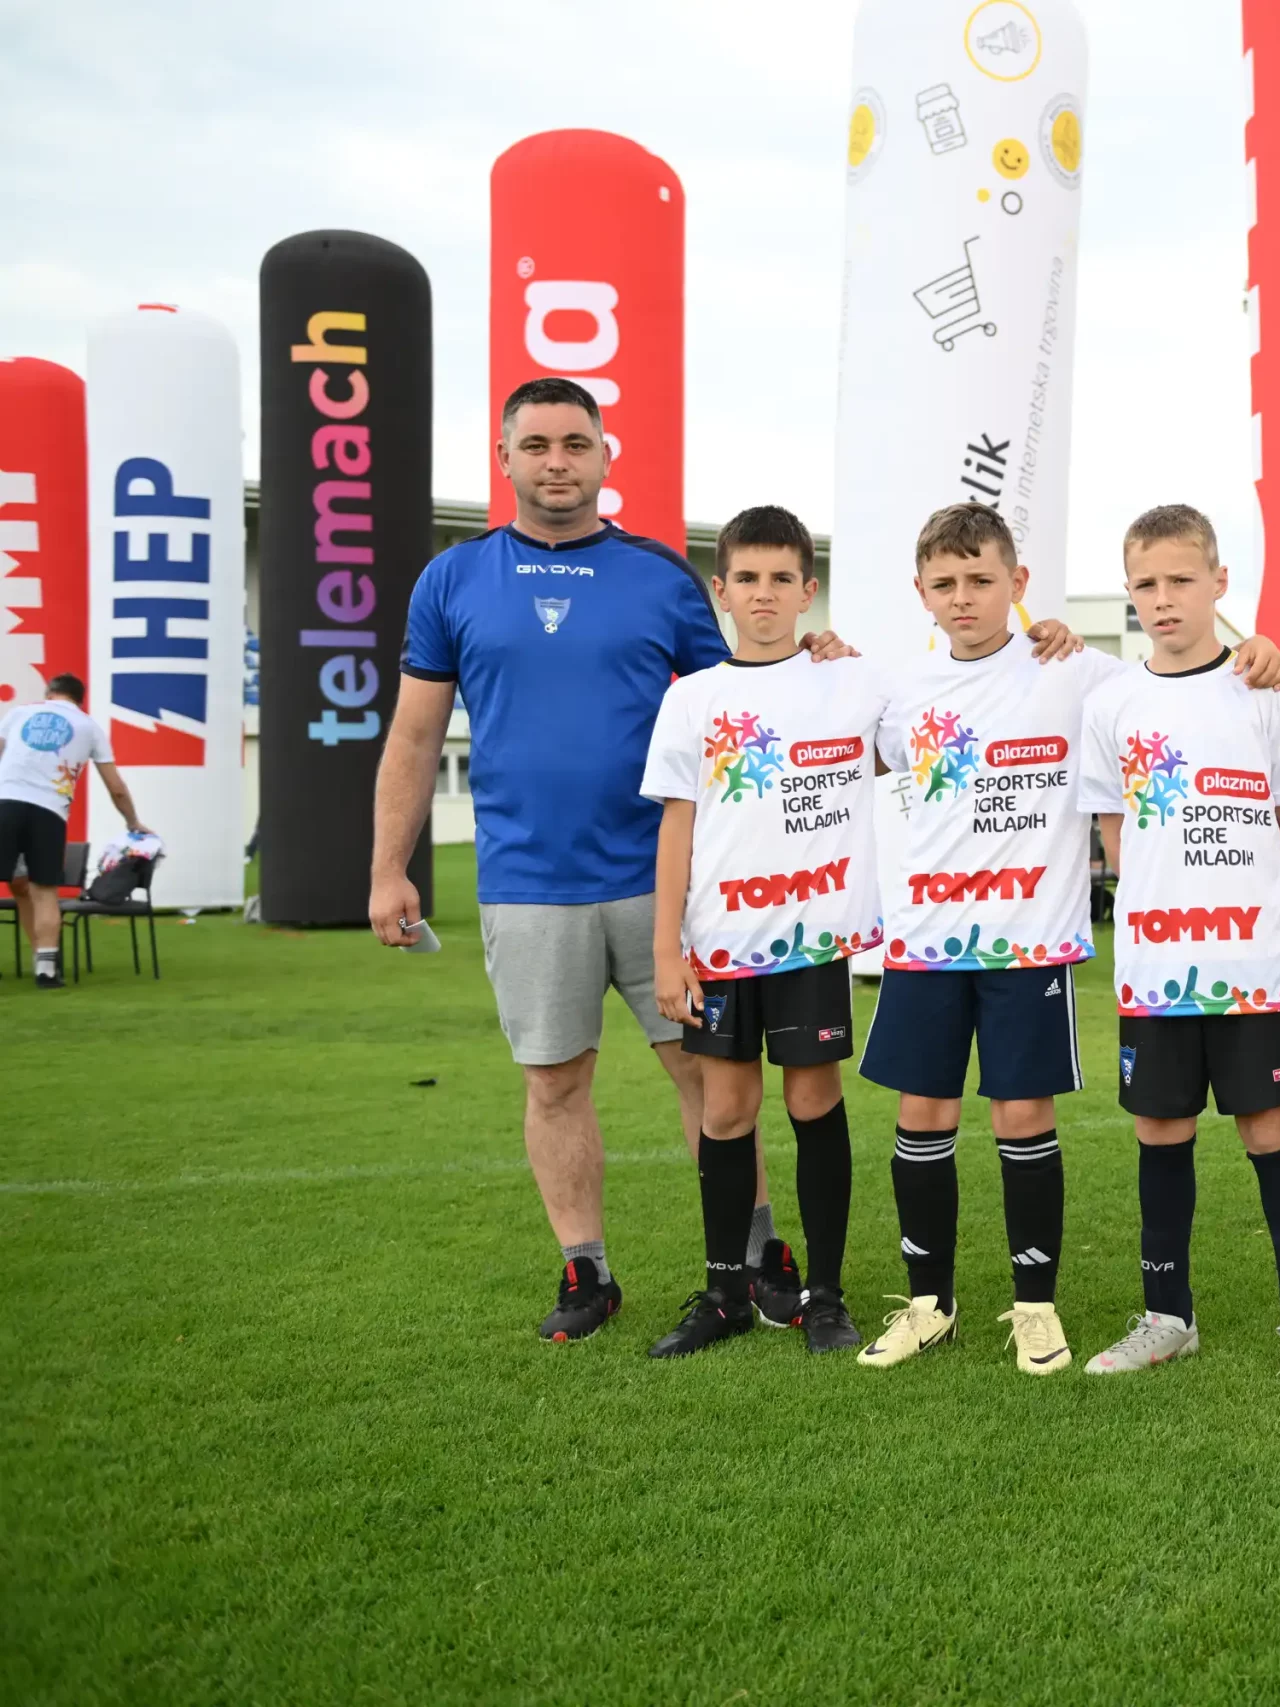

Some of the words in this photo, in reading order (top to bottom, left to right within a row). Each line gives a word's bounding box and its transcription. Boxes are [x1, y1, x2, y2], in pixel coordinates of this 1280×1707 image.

[1038, 256, 1064, 355] trgovina
[1016, 362, 1051, 498] internetska
[290, 310, 381, 747] telemach
[1011, 505, 1031, 555] voja
[516, 564, 595, 577] GIVOVA
[797, 743, 857, 765] plazma
[992, 742, 1058, 764] plazma
[974, 770, 1068, 794] SPORTSKE
[1202, 774, 1266, 794] plazma
[782, 793, 823, 814] IGRE
[974, 795, 1017, 814] IGRE
[785, 807, 851, 834] MLADIH
[973, 813, 1047, 834] MLADIH
[1182, 805, 1272, 827] SPORTSKE
[1183, 827, 1228, 845] IGRE
[1184, 849, 1255, 867] MLADIH
[718, 856, 851, 913] TOMMY
[908, 865, 1048, 905] TOMMY
[1127, 906, 1262, 945] TOMMY
